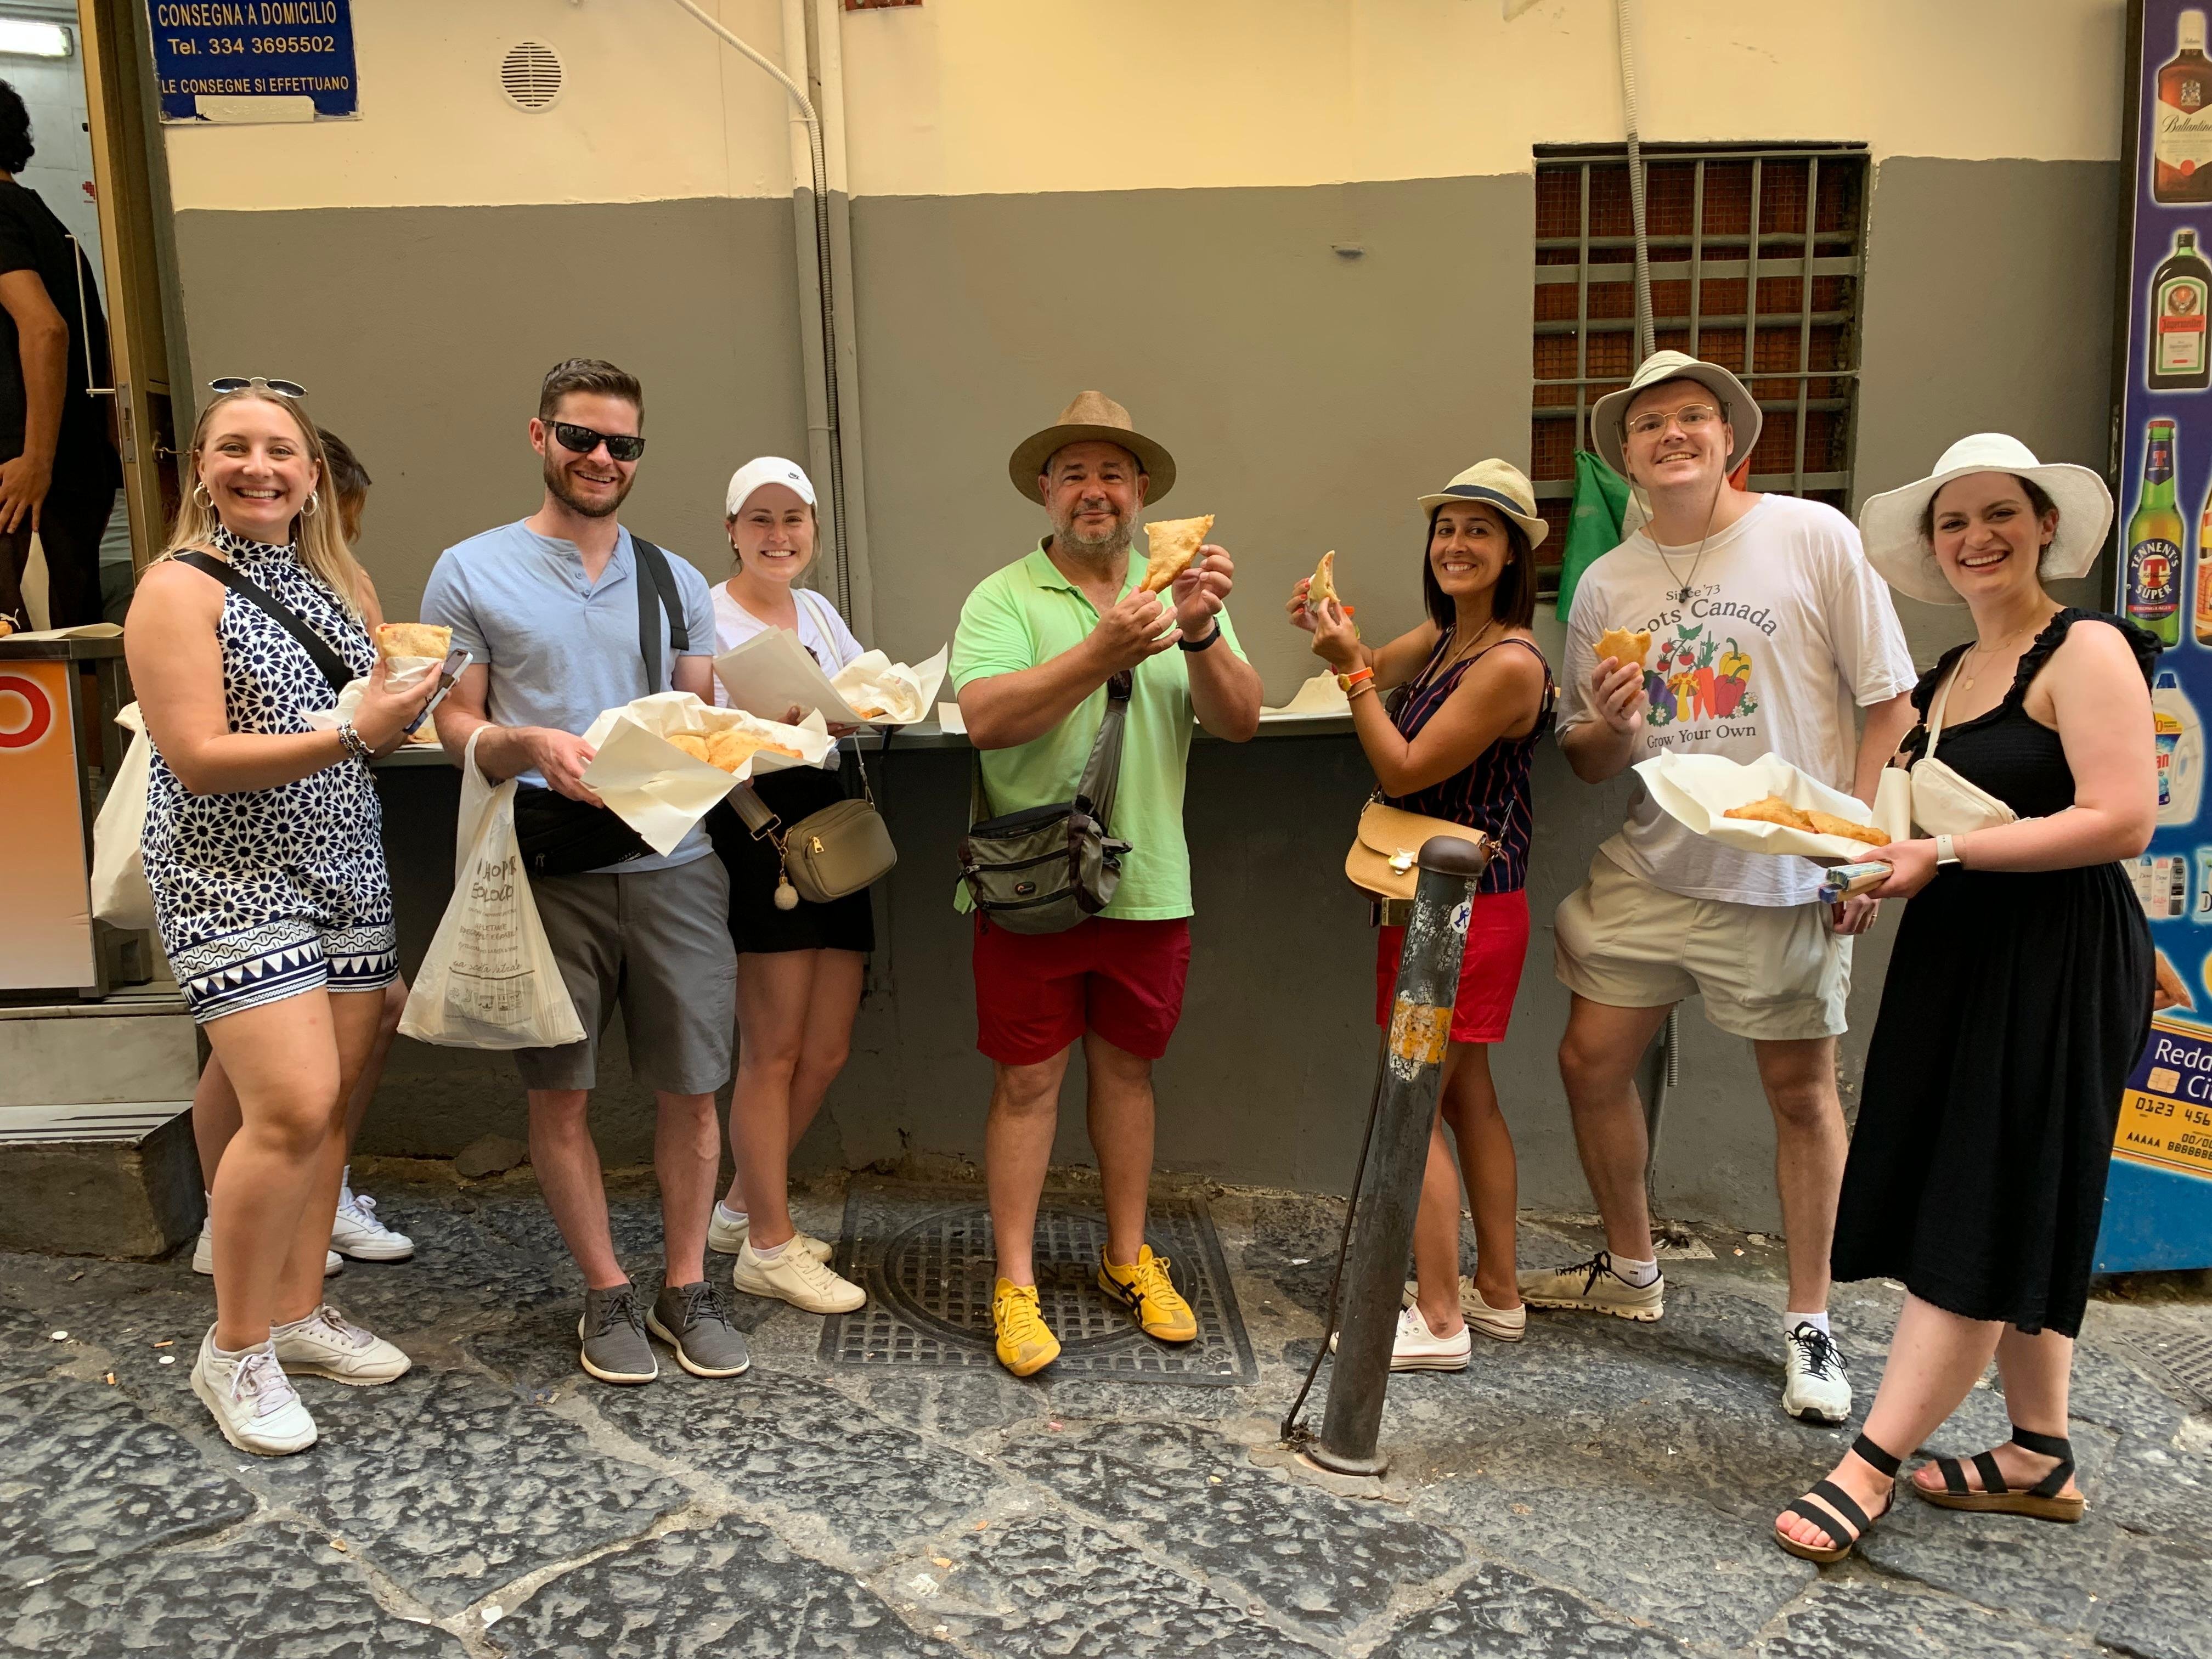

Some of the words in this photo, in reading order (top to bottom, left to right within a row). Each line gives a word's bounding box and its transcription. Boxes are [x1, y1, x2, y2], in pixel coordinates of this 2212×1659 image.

[158, 3, 244, 26] CONSEGNA
[261, 2, 336, 25] DOMICILIO
[167, 38, 201, 54] Tel.
[209, 38, 244, 54] 334
[252, 36, 335, 53] 3695502
[162, 80, 177, 94] LE
[180, 78, 251, 93] CONSEGNE
[255, 78, 266, 92] SI
[270, 76, 348, 92] EFFETTUANO
[2131, 542, 2179, 568] TENNENT'S
[1666, 589, 1701, 601] Sice
[2135, 584, 2172, 600] SUPER
[1691, 599, 1778, 636] Canada
[1647, 735, 1674, 749] Grow
[1679, 729, 1711, 743] Your
[1716, 724, 1756, 738] Own
[2187, 1075, 2212, 1101] Ci
[2136, 1097, 2175, 1117] 0123
[2126, 1132, 2160, 1148] AAAAA
